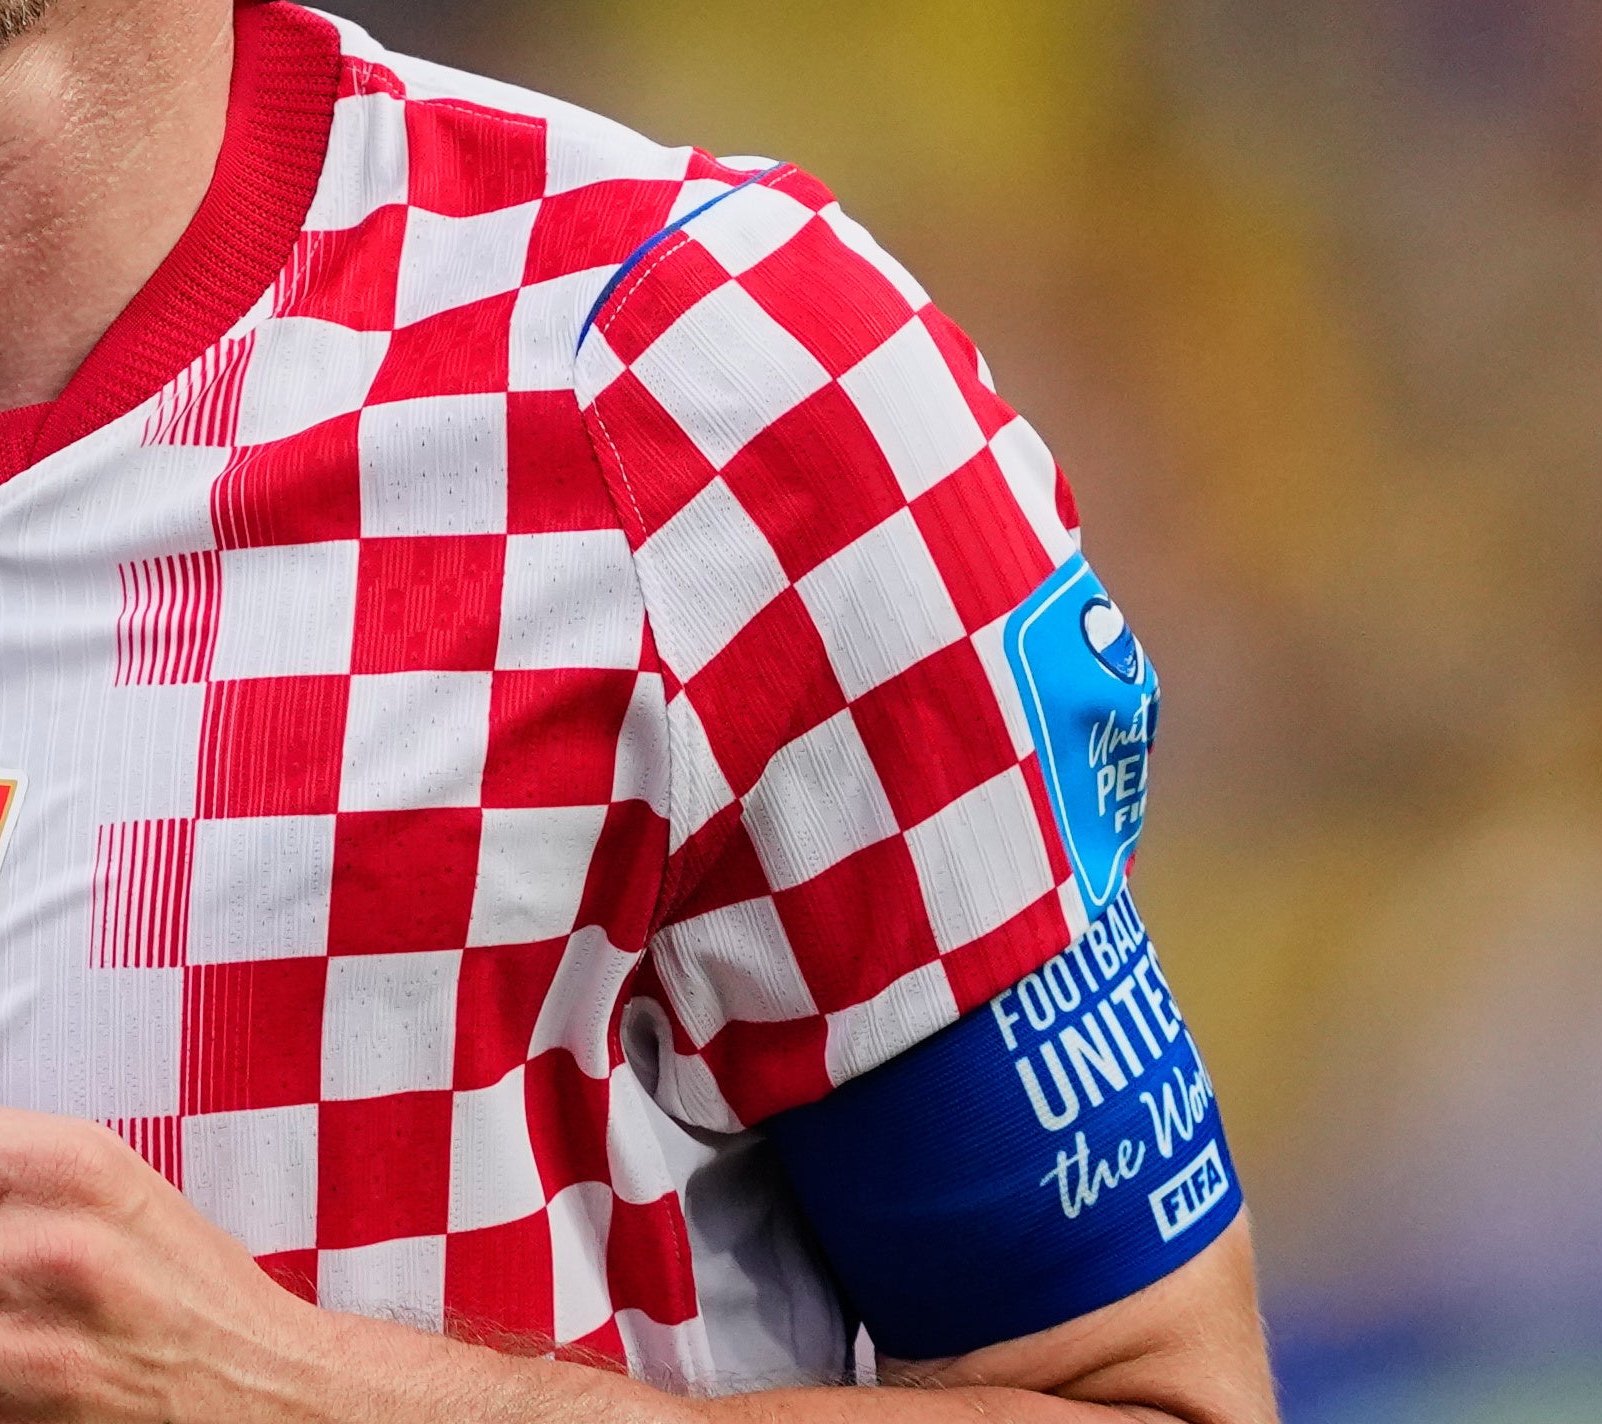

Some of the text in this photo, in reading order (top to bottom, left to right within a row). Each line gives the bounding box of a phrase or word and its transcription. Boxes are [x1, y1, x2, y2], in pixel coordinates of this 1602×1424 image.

[1089, 693, 1152, 768] Unit
[1039, 1029, 1214, 1219] the Worl
[1158, 1153, 1225, 1229] FIFA
